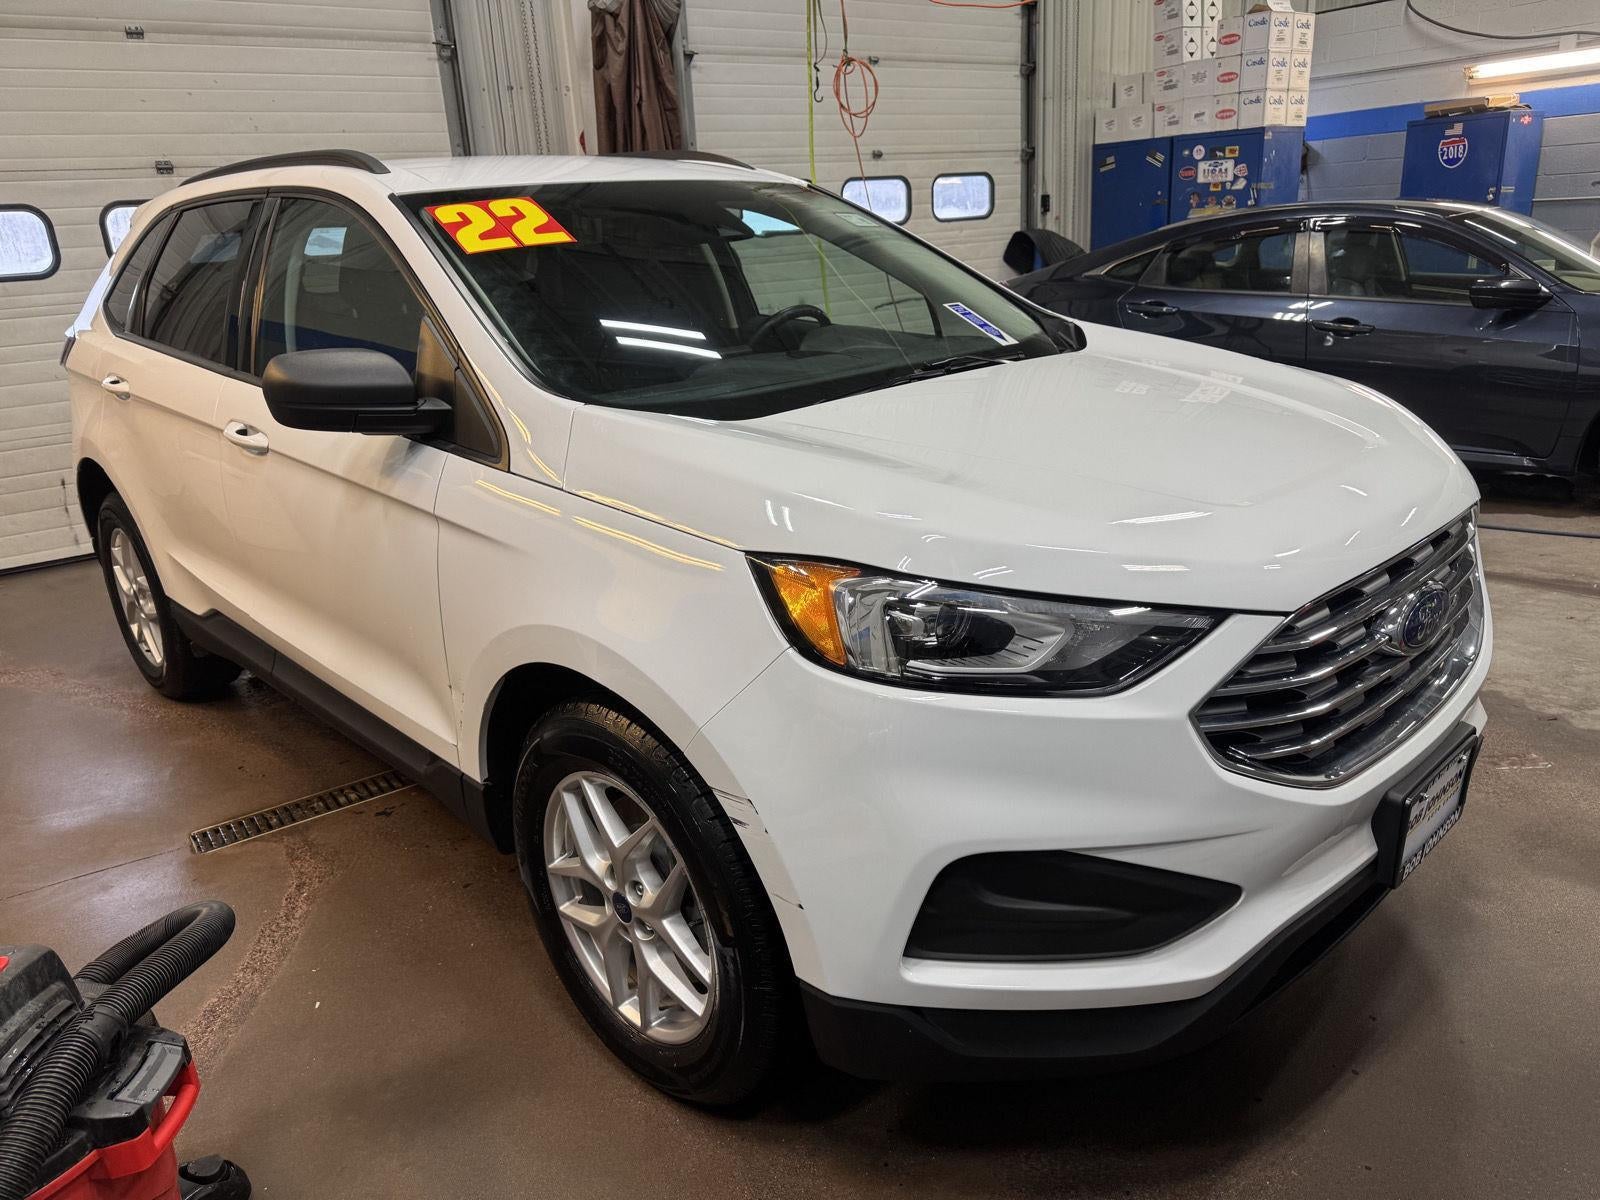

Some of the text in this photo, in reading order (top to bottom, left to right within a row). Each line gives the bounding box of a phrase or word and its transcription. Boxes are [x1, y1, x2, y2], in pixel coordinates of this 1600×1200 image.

[1442, 145, 1464, 159] 2018
[434, 199, 572, 254] 22
[1402, 806, 1462, 881] BOB JOHNSON
